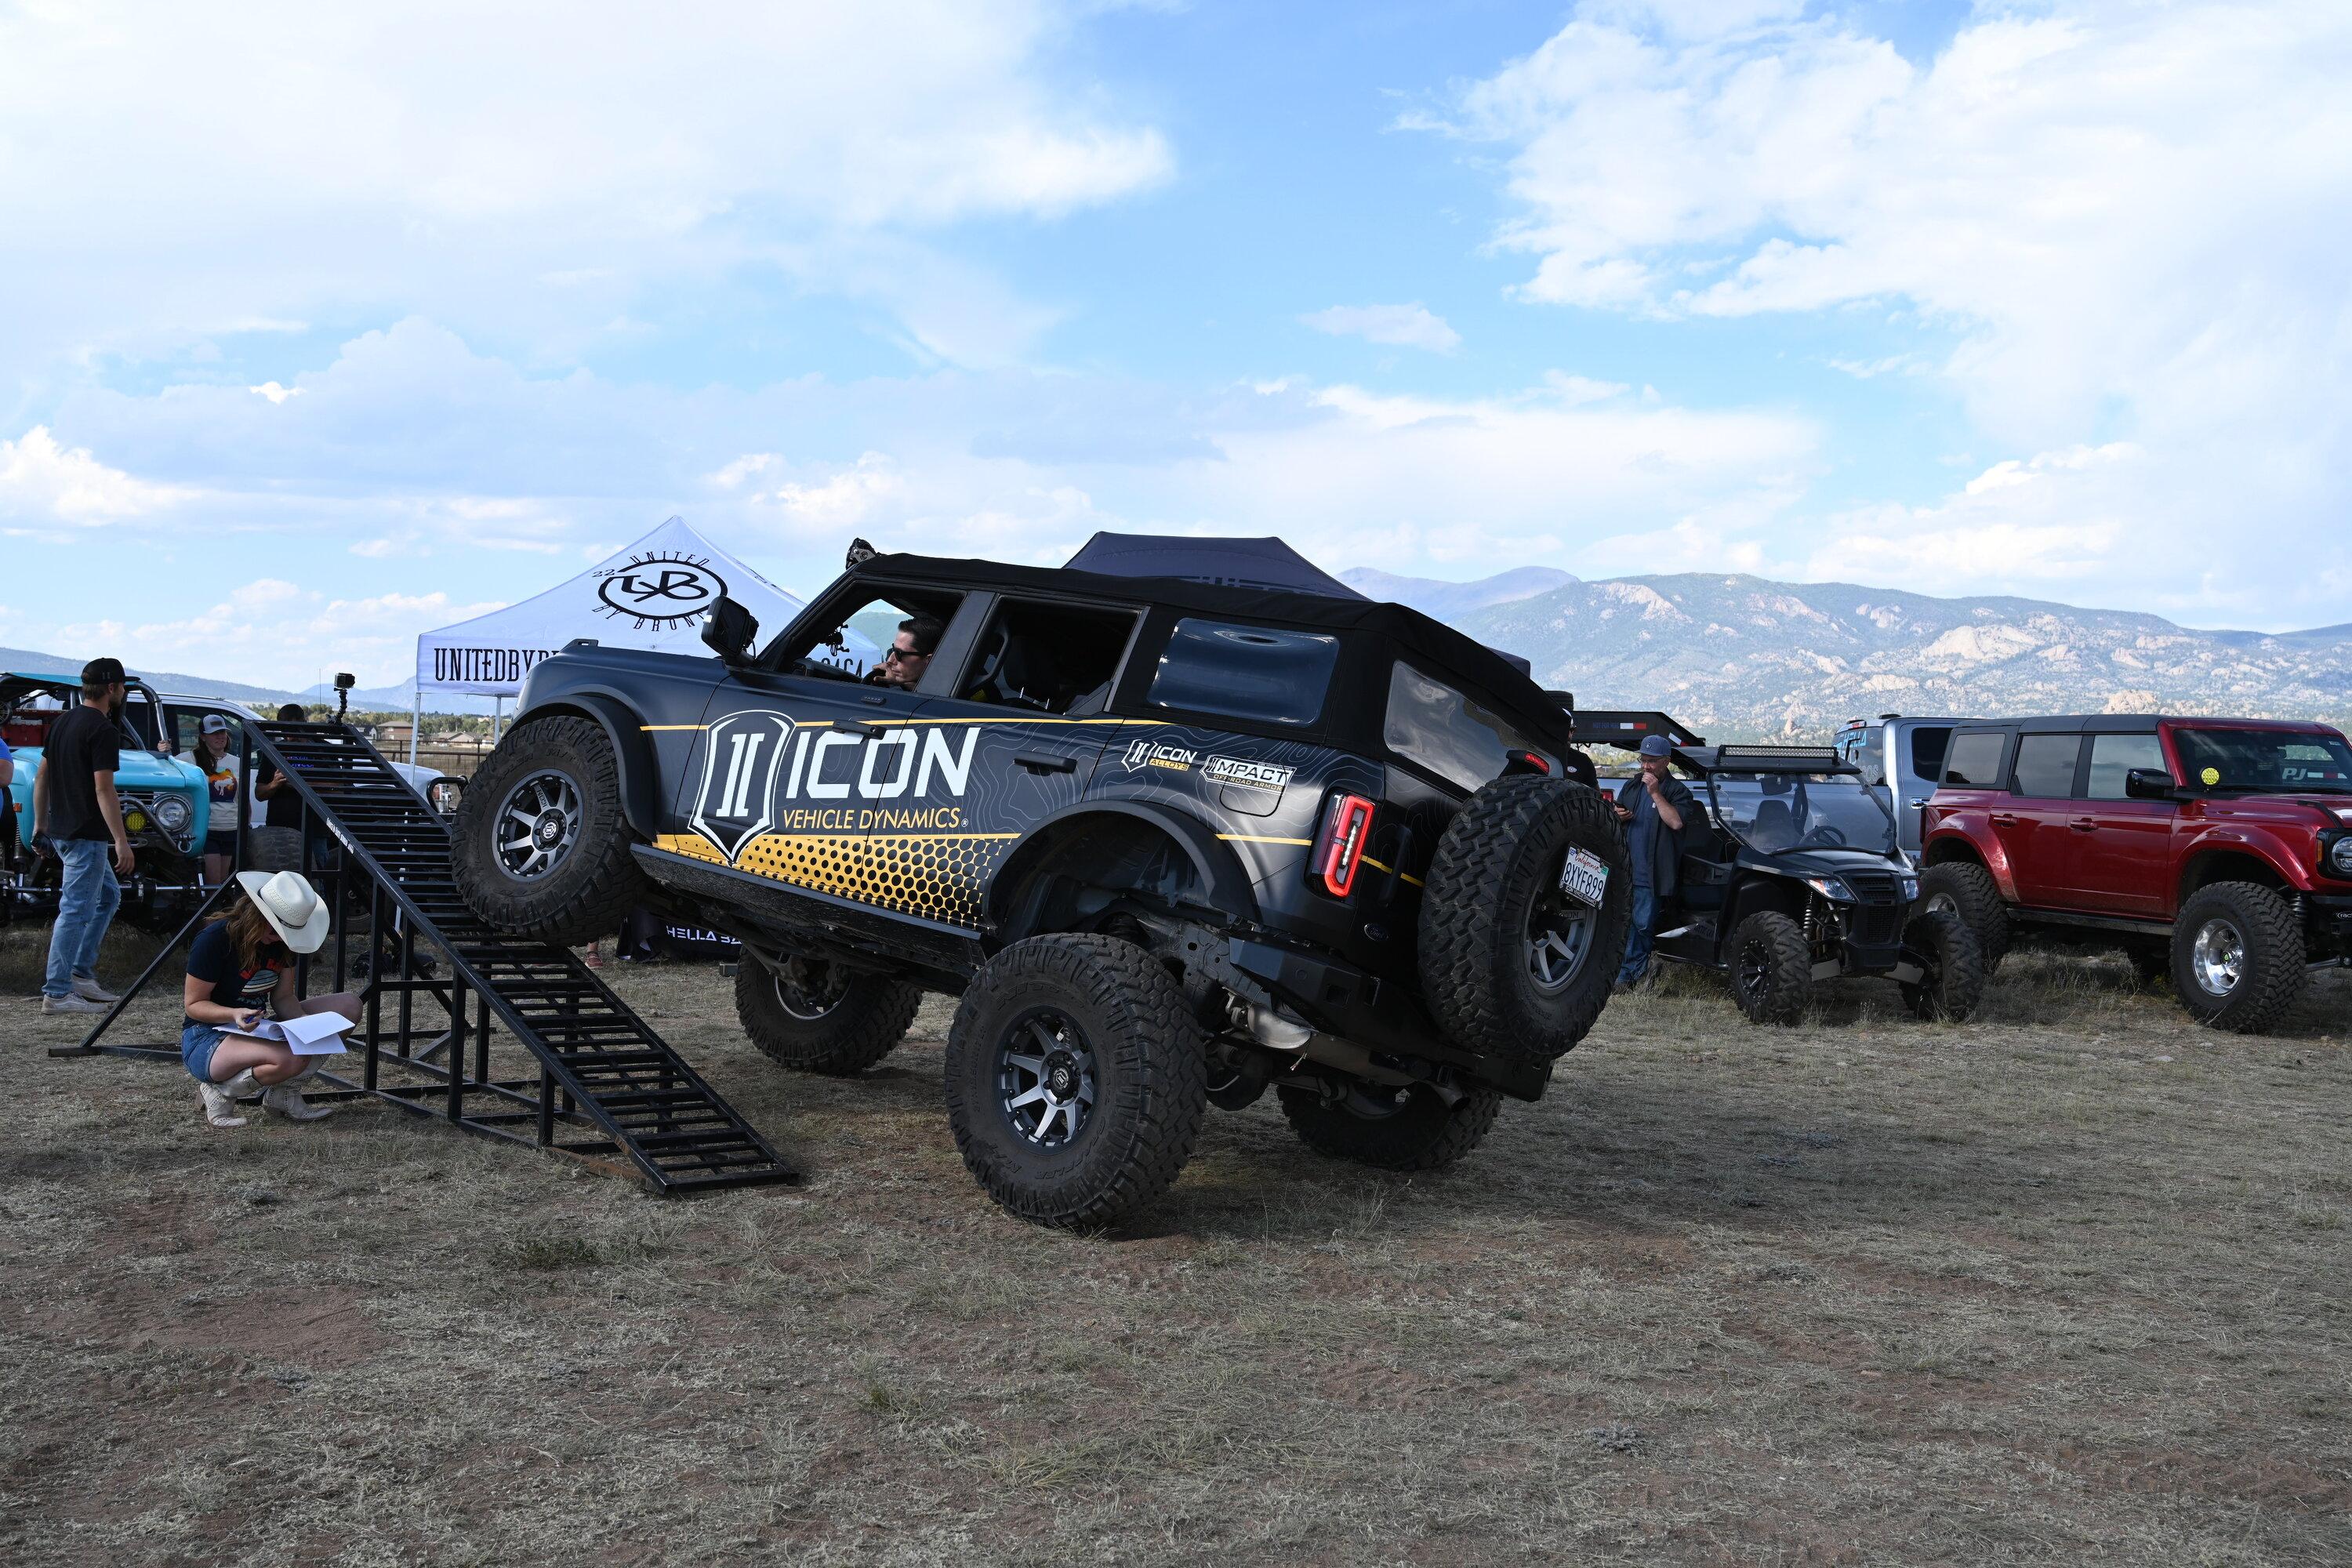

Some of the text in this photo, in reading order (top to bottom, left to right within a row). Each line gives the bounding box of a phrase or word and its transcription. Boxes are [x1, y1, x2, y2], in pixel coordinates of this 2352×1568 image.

[630, 550, 710, 568] UNITED
[633, 612, 704, 633] BRON
[434, 648, 560, 682] UNITEDBY
[786, 727, 982, 800] ICON
[1152, 745, 1198, 764] ICON
[1150, 759, 1189, 771] ALLOYS
[2281, 768, 2307, 781] PJ
[1213, 774, 1283, 792] OFF-ROAD ARMOR
[784, 807, 961, 829] VEHICLE DYNAMICS
[1563, 862, 1604, 899] 8XYF899
[666, 924, 717, 942] HELLA
